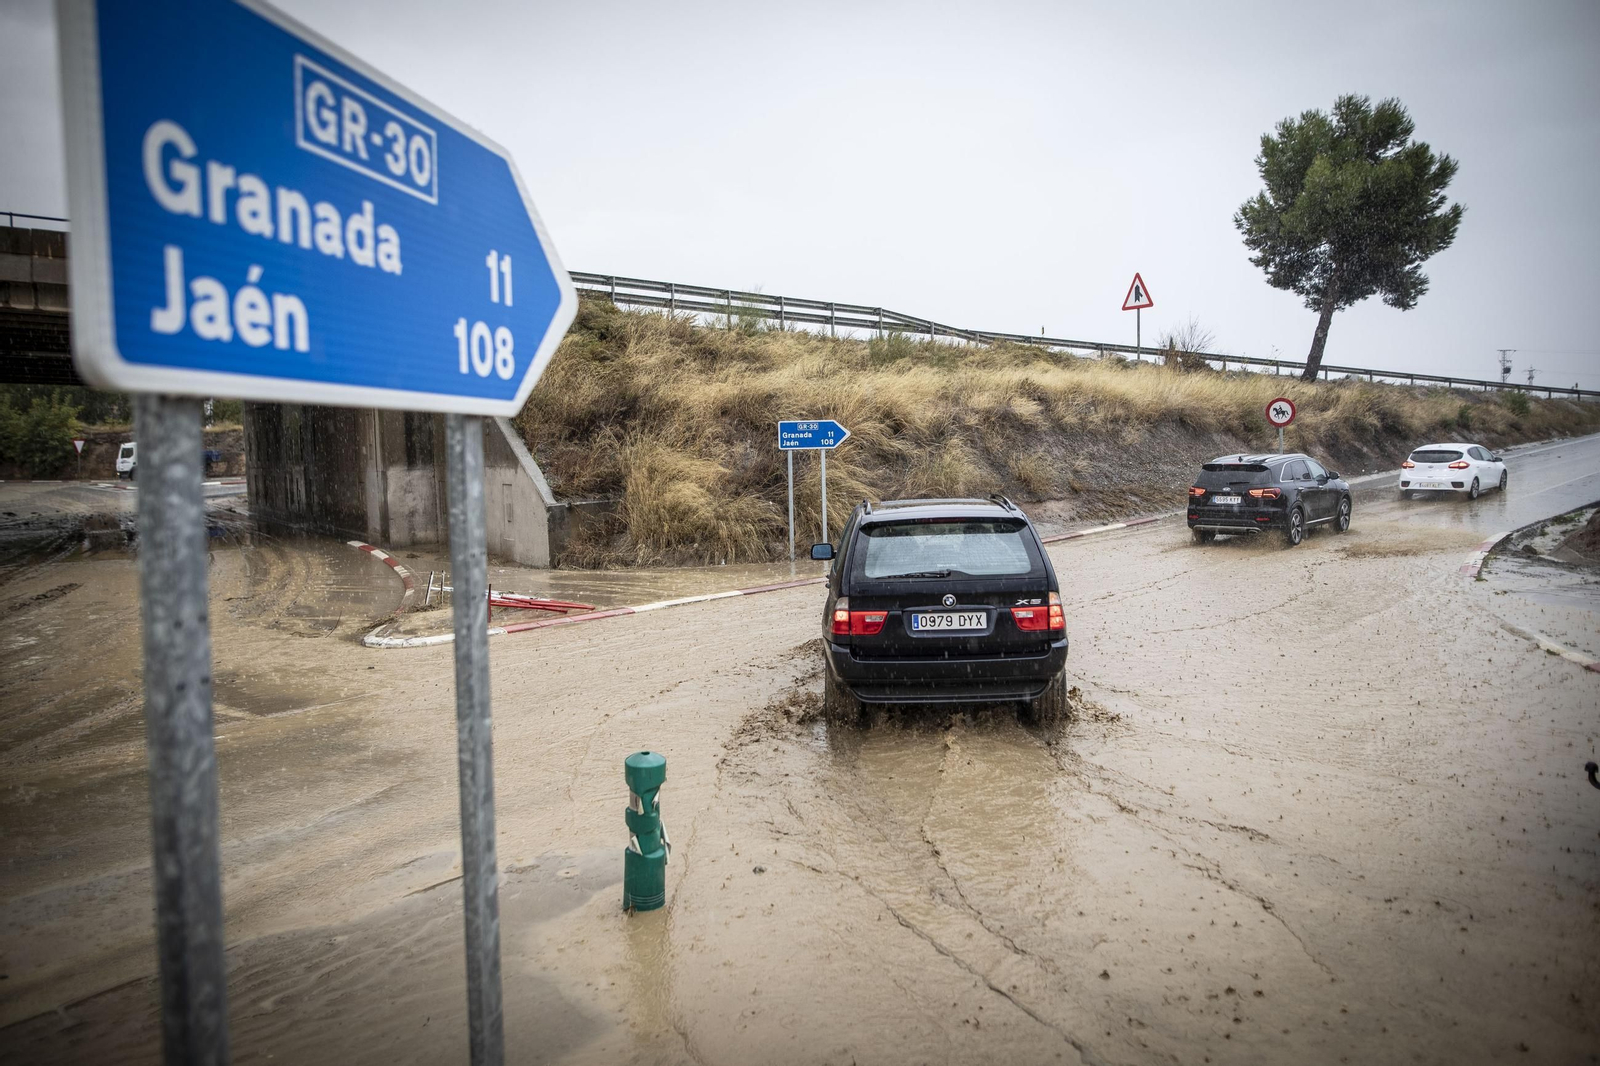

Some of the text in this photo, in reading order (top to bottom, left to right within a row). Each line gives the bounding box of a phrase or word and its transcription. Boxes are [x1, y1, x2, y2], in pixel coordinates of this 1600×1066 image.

[305, 80, 433, 188] GR-30
[142, 119, 402, 276] Granada
[151, 244, 310, 353] Jaén
[486, 249, 514, 307] 11
[454, 317, 515, 380] 108
[920, 614, 983, 628] 0979 DYX
[1015, 598, 1042, 606] X5
